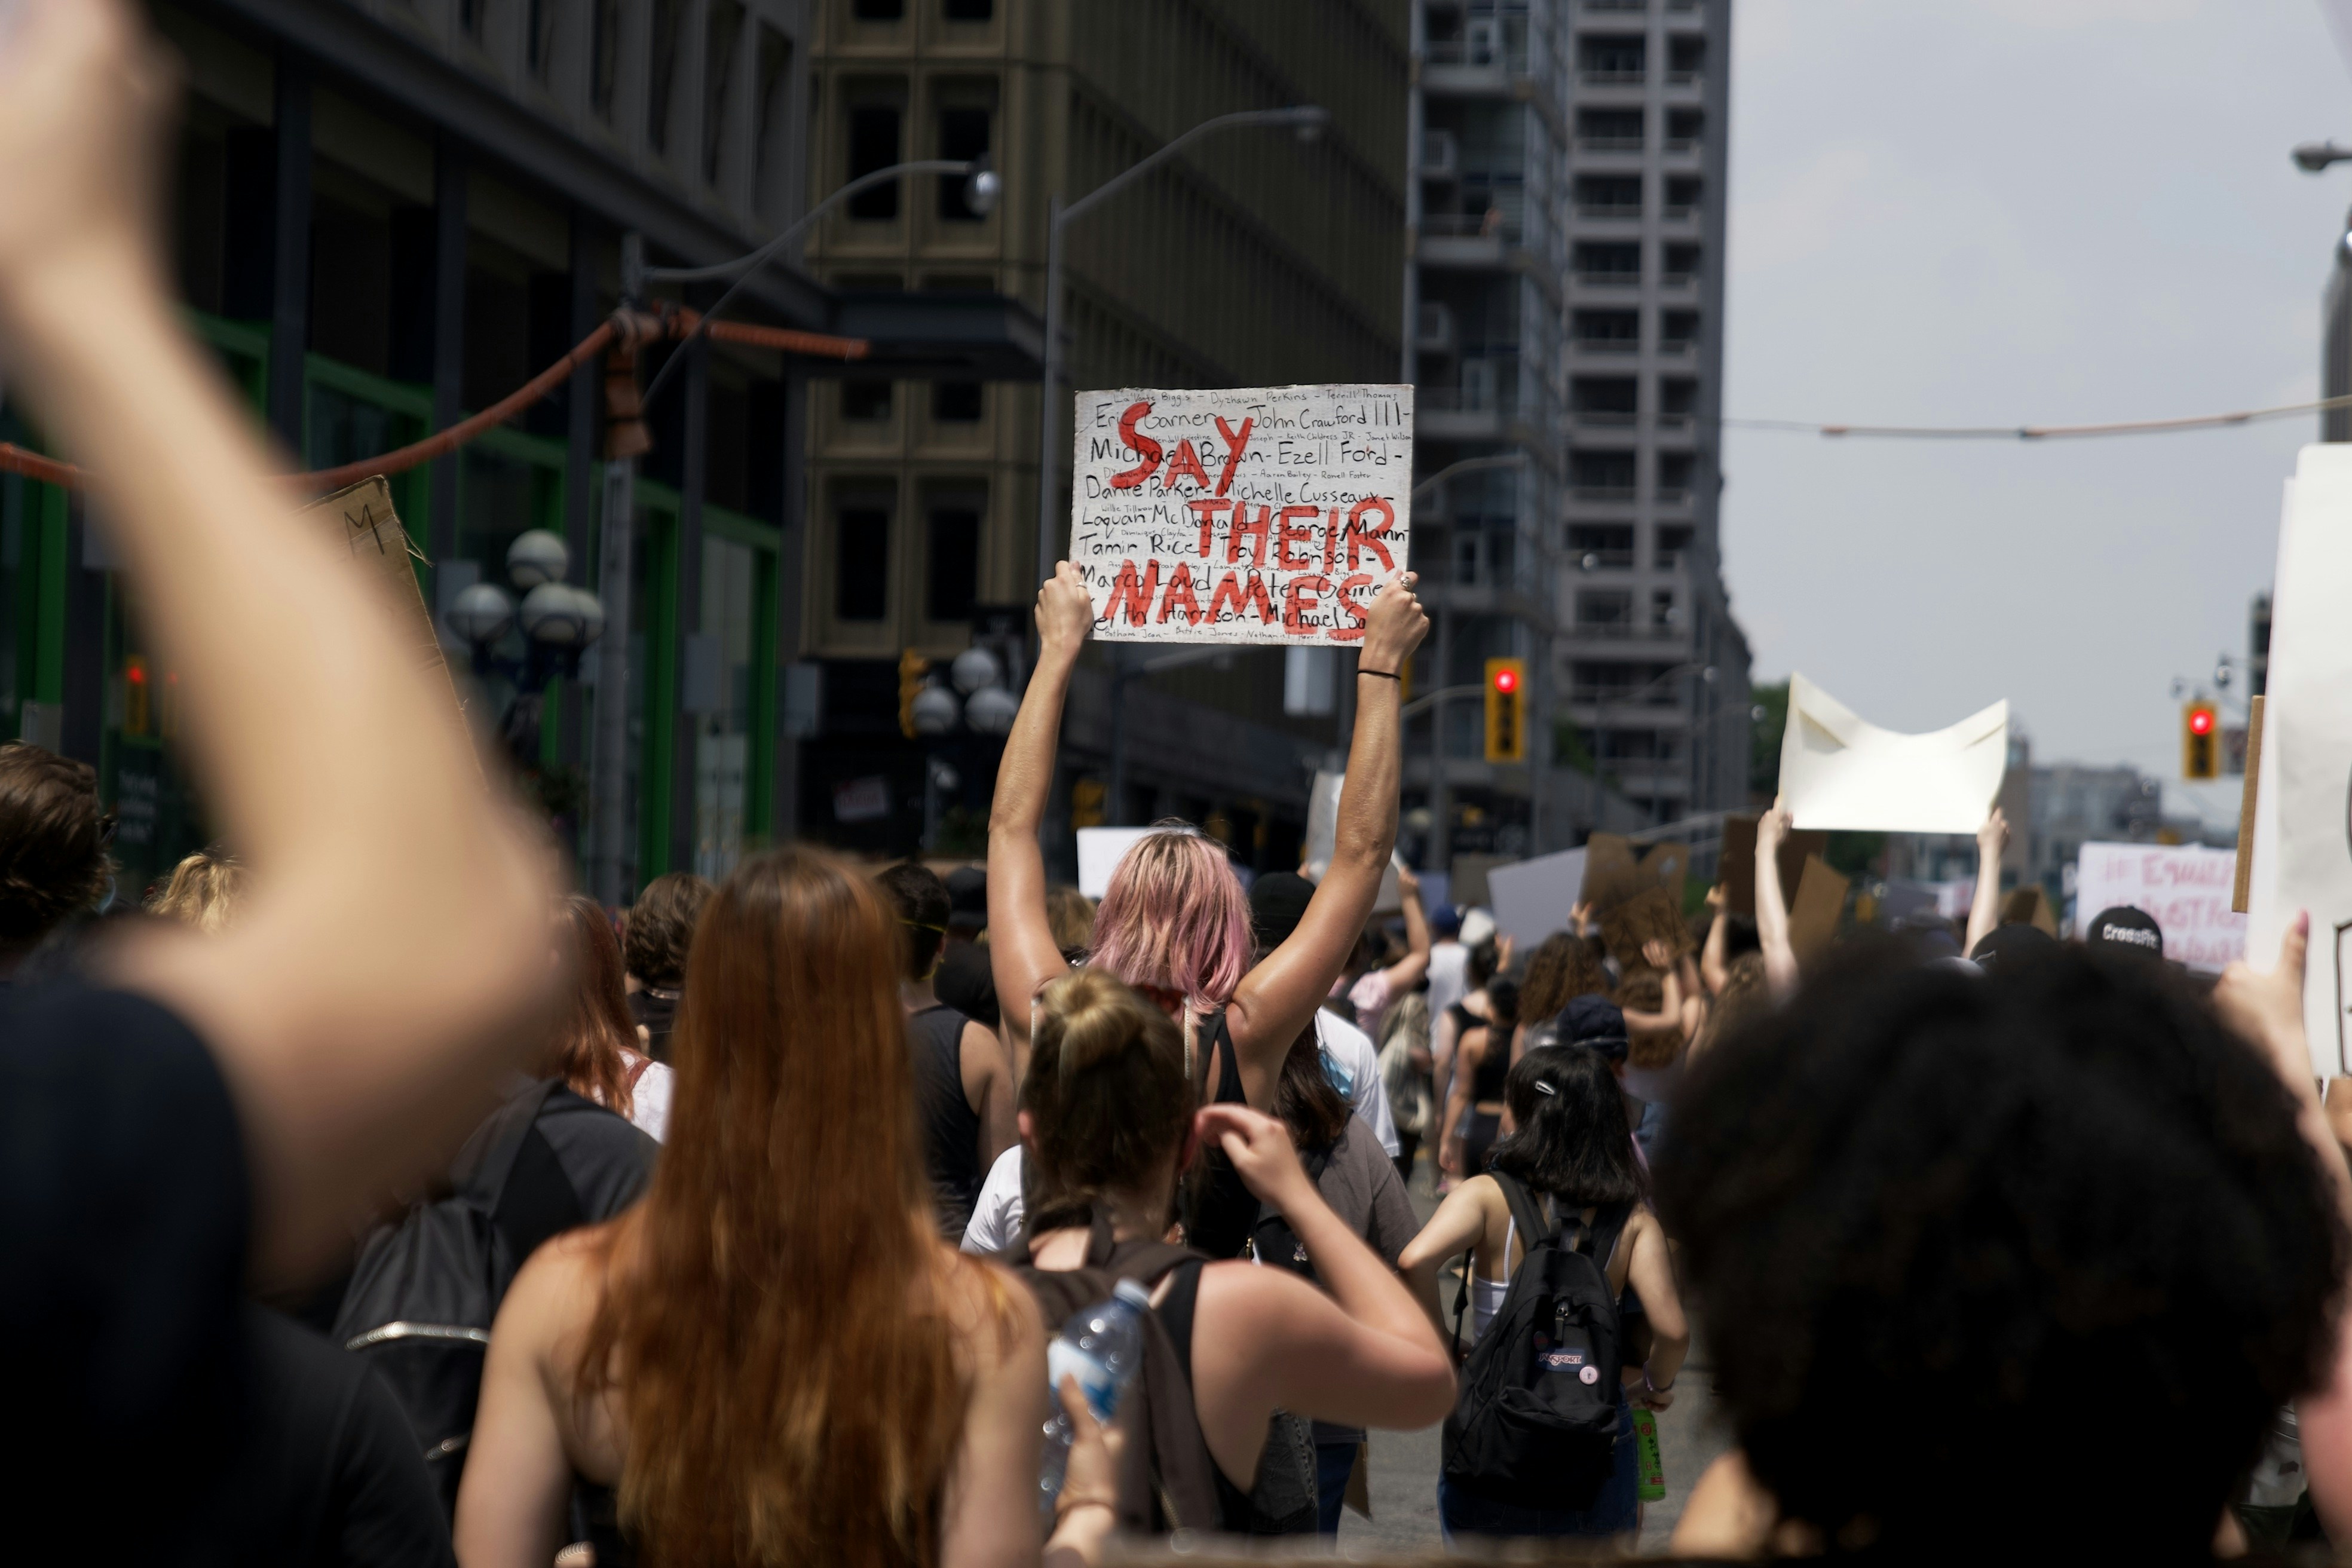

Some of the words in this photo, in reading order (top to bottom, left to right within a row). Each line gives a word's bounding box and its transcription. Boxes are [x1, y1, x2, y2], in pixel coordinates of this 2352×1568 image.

[1161, 391, 1190, 407] Biggs
[1211, 392, 1257, 408] Dyzhawn
[1362, 388, 1397, 401] Thomas
[1144, 402, 1216, 429] Garner
[1247, 405, 1294, 429] John
[1299, 405, 1367, 429] Crawford
[1090, 437, 1186, 471] Michael
[1278, 439, 1328, 466] Ezell
[1341, 440, 1386, 466] Ford
[1110, 401, 1254, 497] SAY
[1248, 434, 1273, 444] Joseph
[1286, 433, 1305, 441] Keith
[1342, 431, 1355, 440] JR
[1086, 475, 1143, 498] Dante
[1220, 479, 1295, 504] Michelle
[1300, 482, 1379, 503] Cusseaux
[1260, 468, 1284, 477] Aaron
[1287, 470, 1310, 481] Bailey
[1349, 470, 1370, 479] Foster
[1082, 506, 1146, 539] Laquan
[1269, 512, 1339, 550] George
[1160, 527, 1186, 538] Clayton
[1186, 497, 1395, 573] THEIR
[1079, 532, 1138, 556] Tamir
[1150, 534, 1200, 555] Rice
[1219, 535, 1260, 571] Troy
[1272, 541, 1359, 565] Robinson
[1079, 564, 1146, 588] Marco
[1156, 565, 1211, 591] Loud
[1246, 567, 1303, 599] Peter
[1316, 572, 1383, 599] Gaine
[1091, 598, 1147, 632] eith
[1162, 596, 1246, 624] Harrison
[1263, 602, 1340, 631] Michael
[1102, 559, 1373, 642] NAMES
[1140, 629, 1162, 639] Jean
[1208, 627, 1238, 636] Jones
